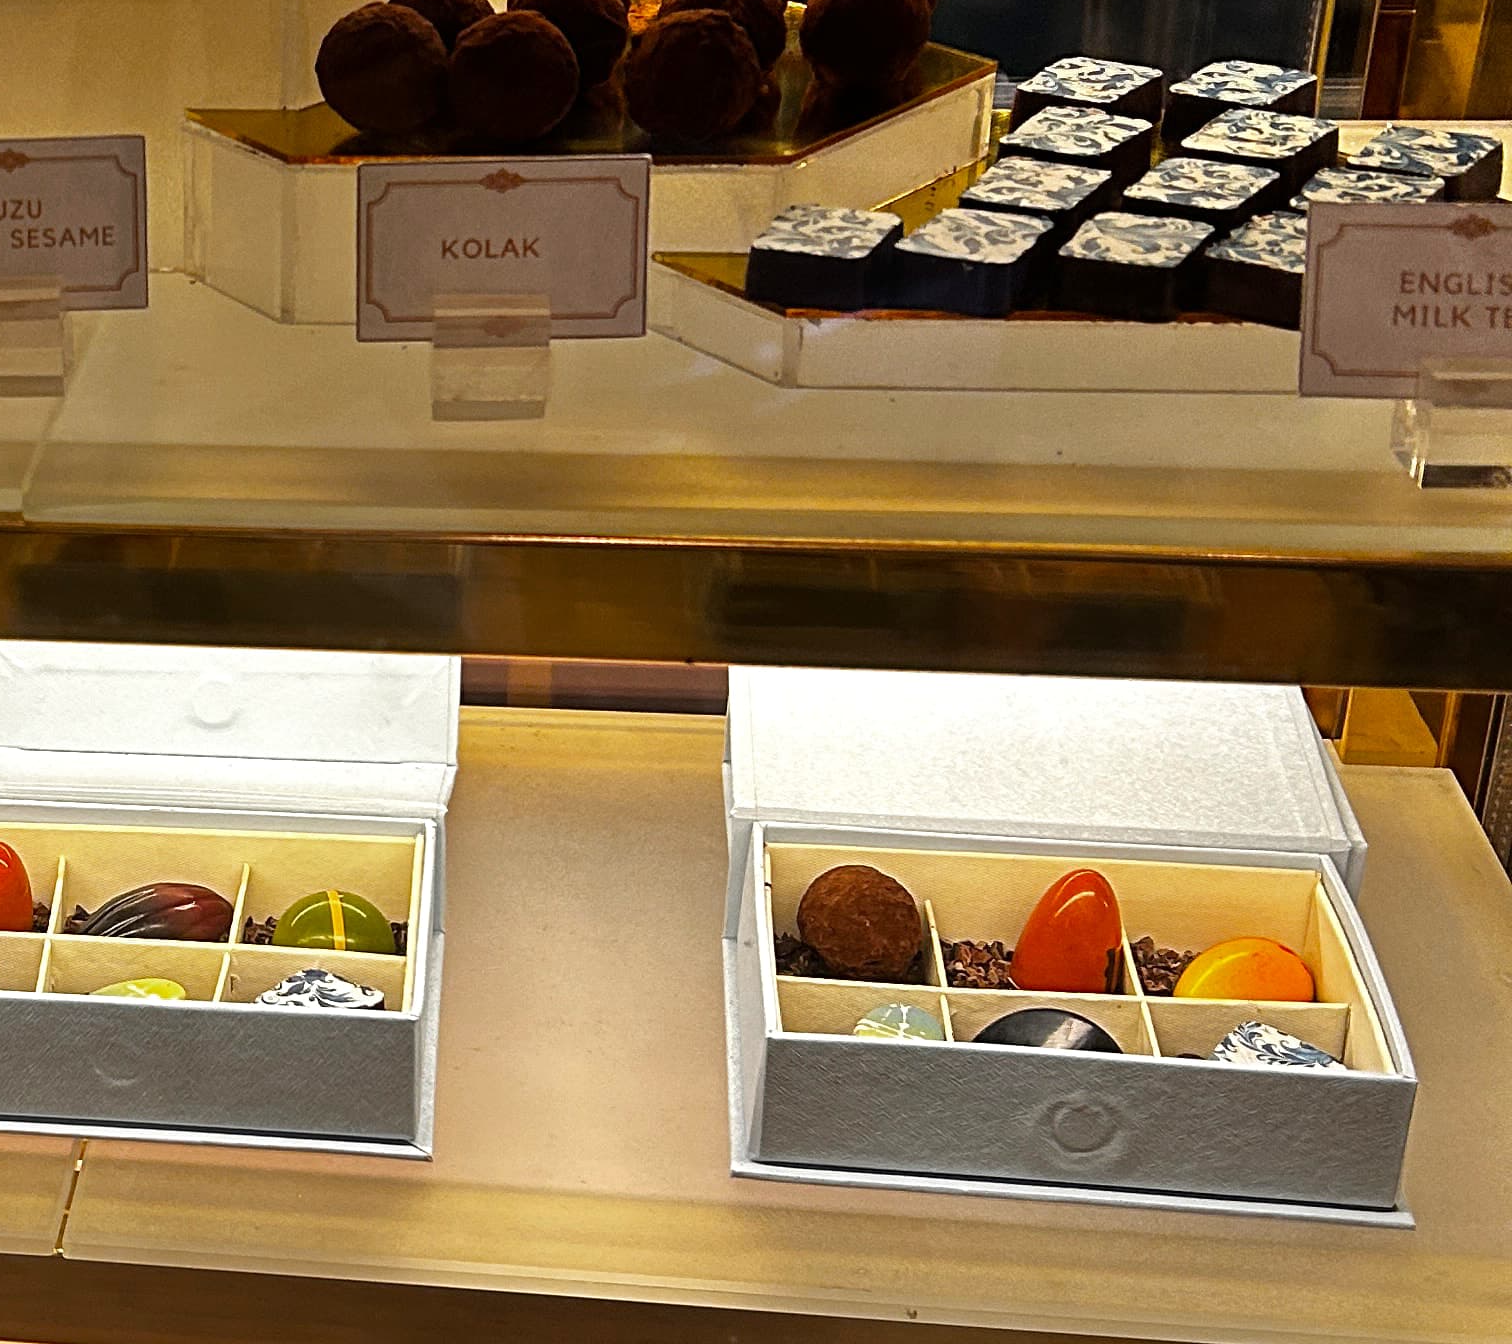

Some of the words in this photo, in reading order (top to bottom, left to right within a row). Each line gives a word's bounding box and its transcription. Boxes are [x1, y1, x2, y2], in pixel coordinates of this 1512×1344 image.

[10, 225, 116, 249] SESAME
[441, 237, 540, 260] KOLAK
[1399, 271, 1512, 296] ENGLIS
[1392, 305, 1471, 329] MILK
